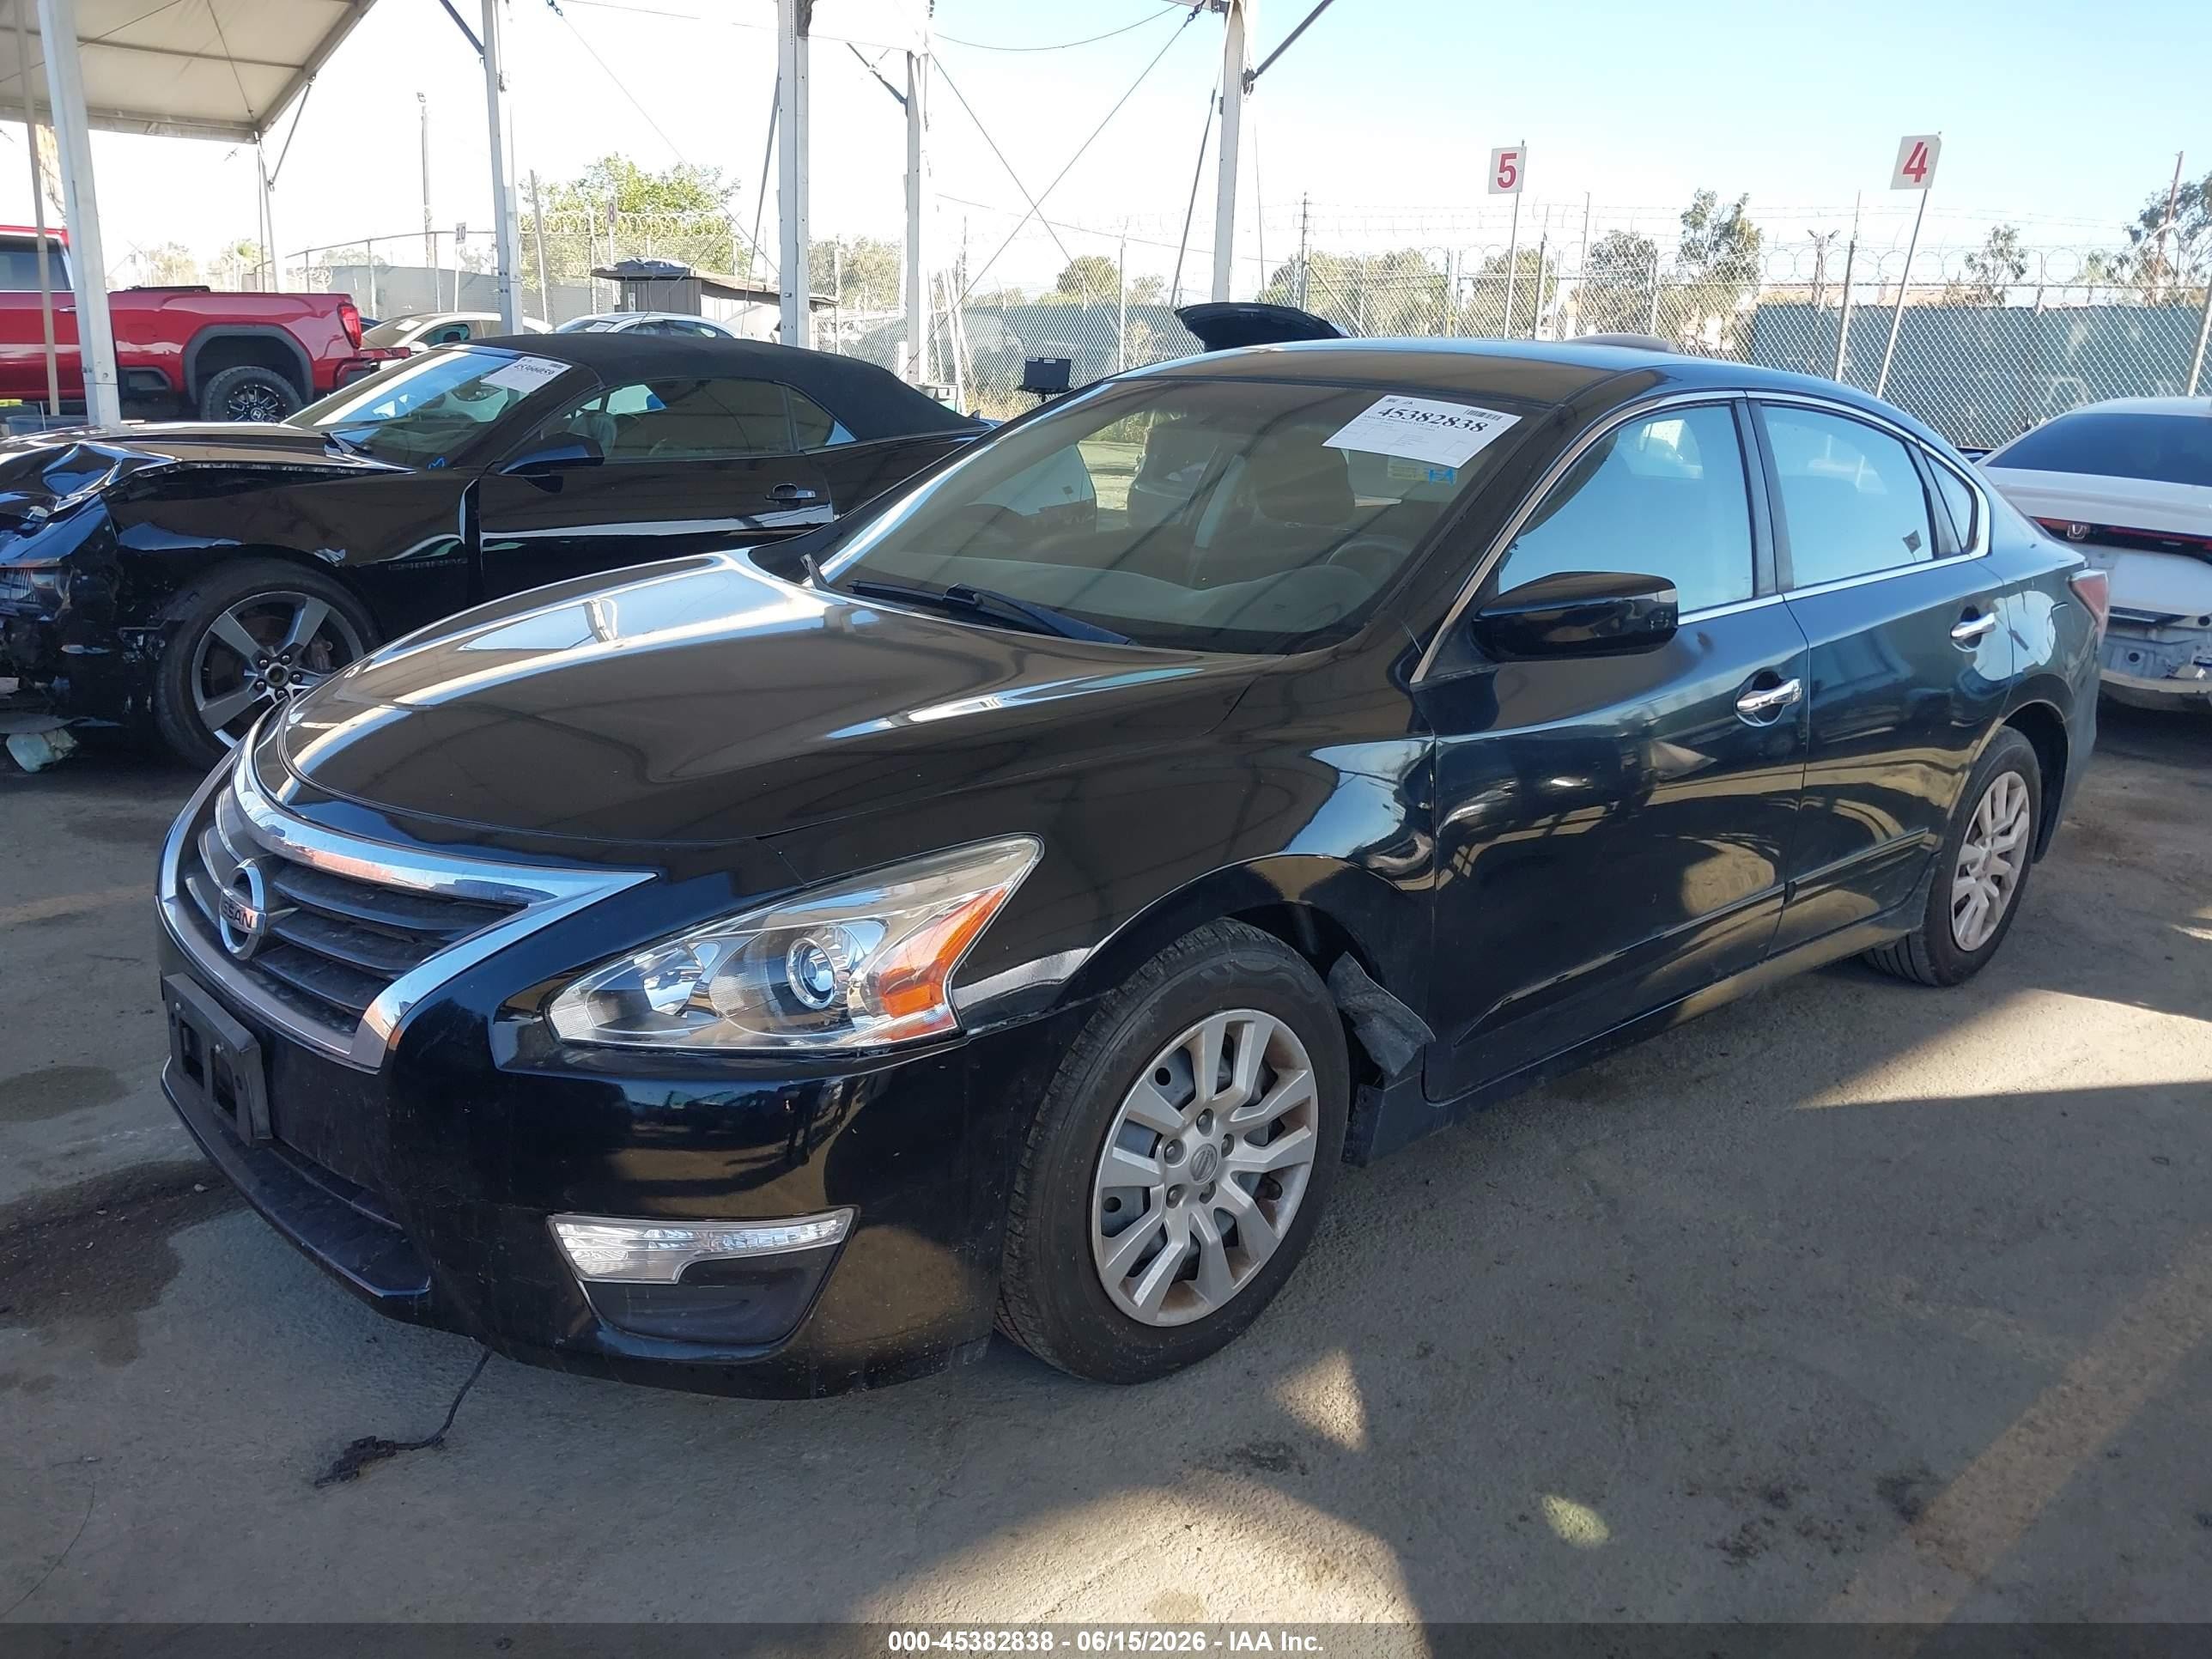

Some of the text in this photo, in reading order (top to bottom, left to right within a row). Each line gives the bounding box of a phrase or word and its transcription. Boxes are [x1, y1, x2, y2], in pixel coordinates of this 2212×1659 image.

[1496, 152, 1518, 189] 5
[1902, 141, 1929, 183] 4
[608, 202, 616, 223] 8
[456, 226, 466, 240] 10
[1377, 407, 1489, 433] 45382838
